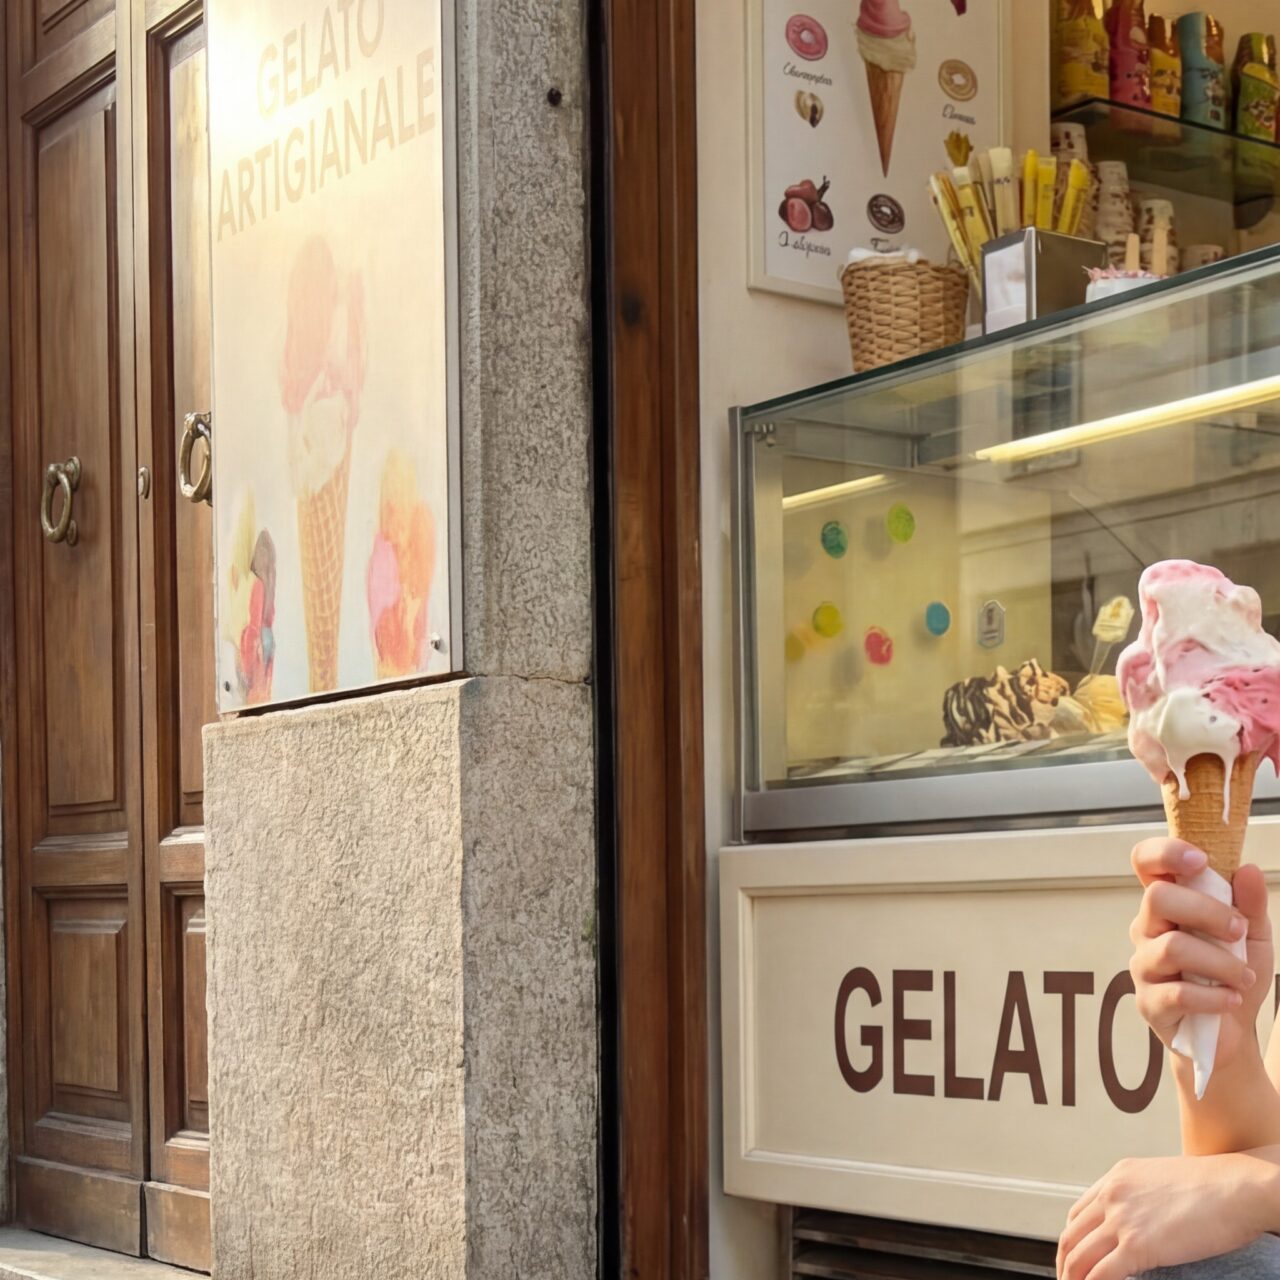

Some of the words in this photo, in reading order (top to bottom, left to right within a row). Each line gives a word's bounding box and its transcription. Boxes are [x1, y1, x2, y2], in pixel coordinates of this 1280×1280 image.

[257, 0, 385, 120] GELATO
[217, 46, 436, 243] ARTIGIANALE
[834, 966, 1164, 1114] GELATO
